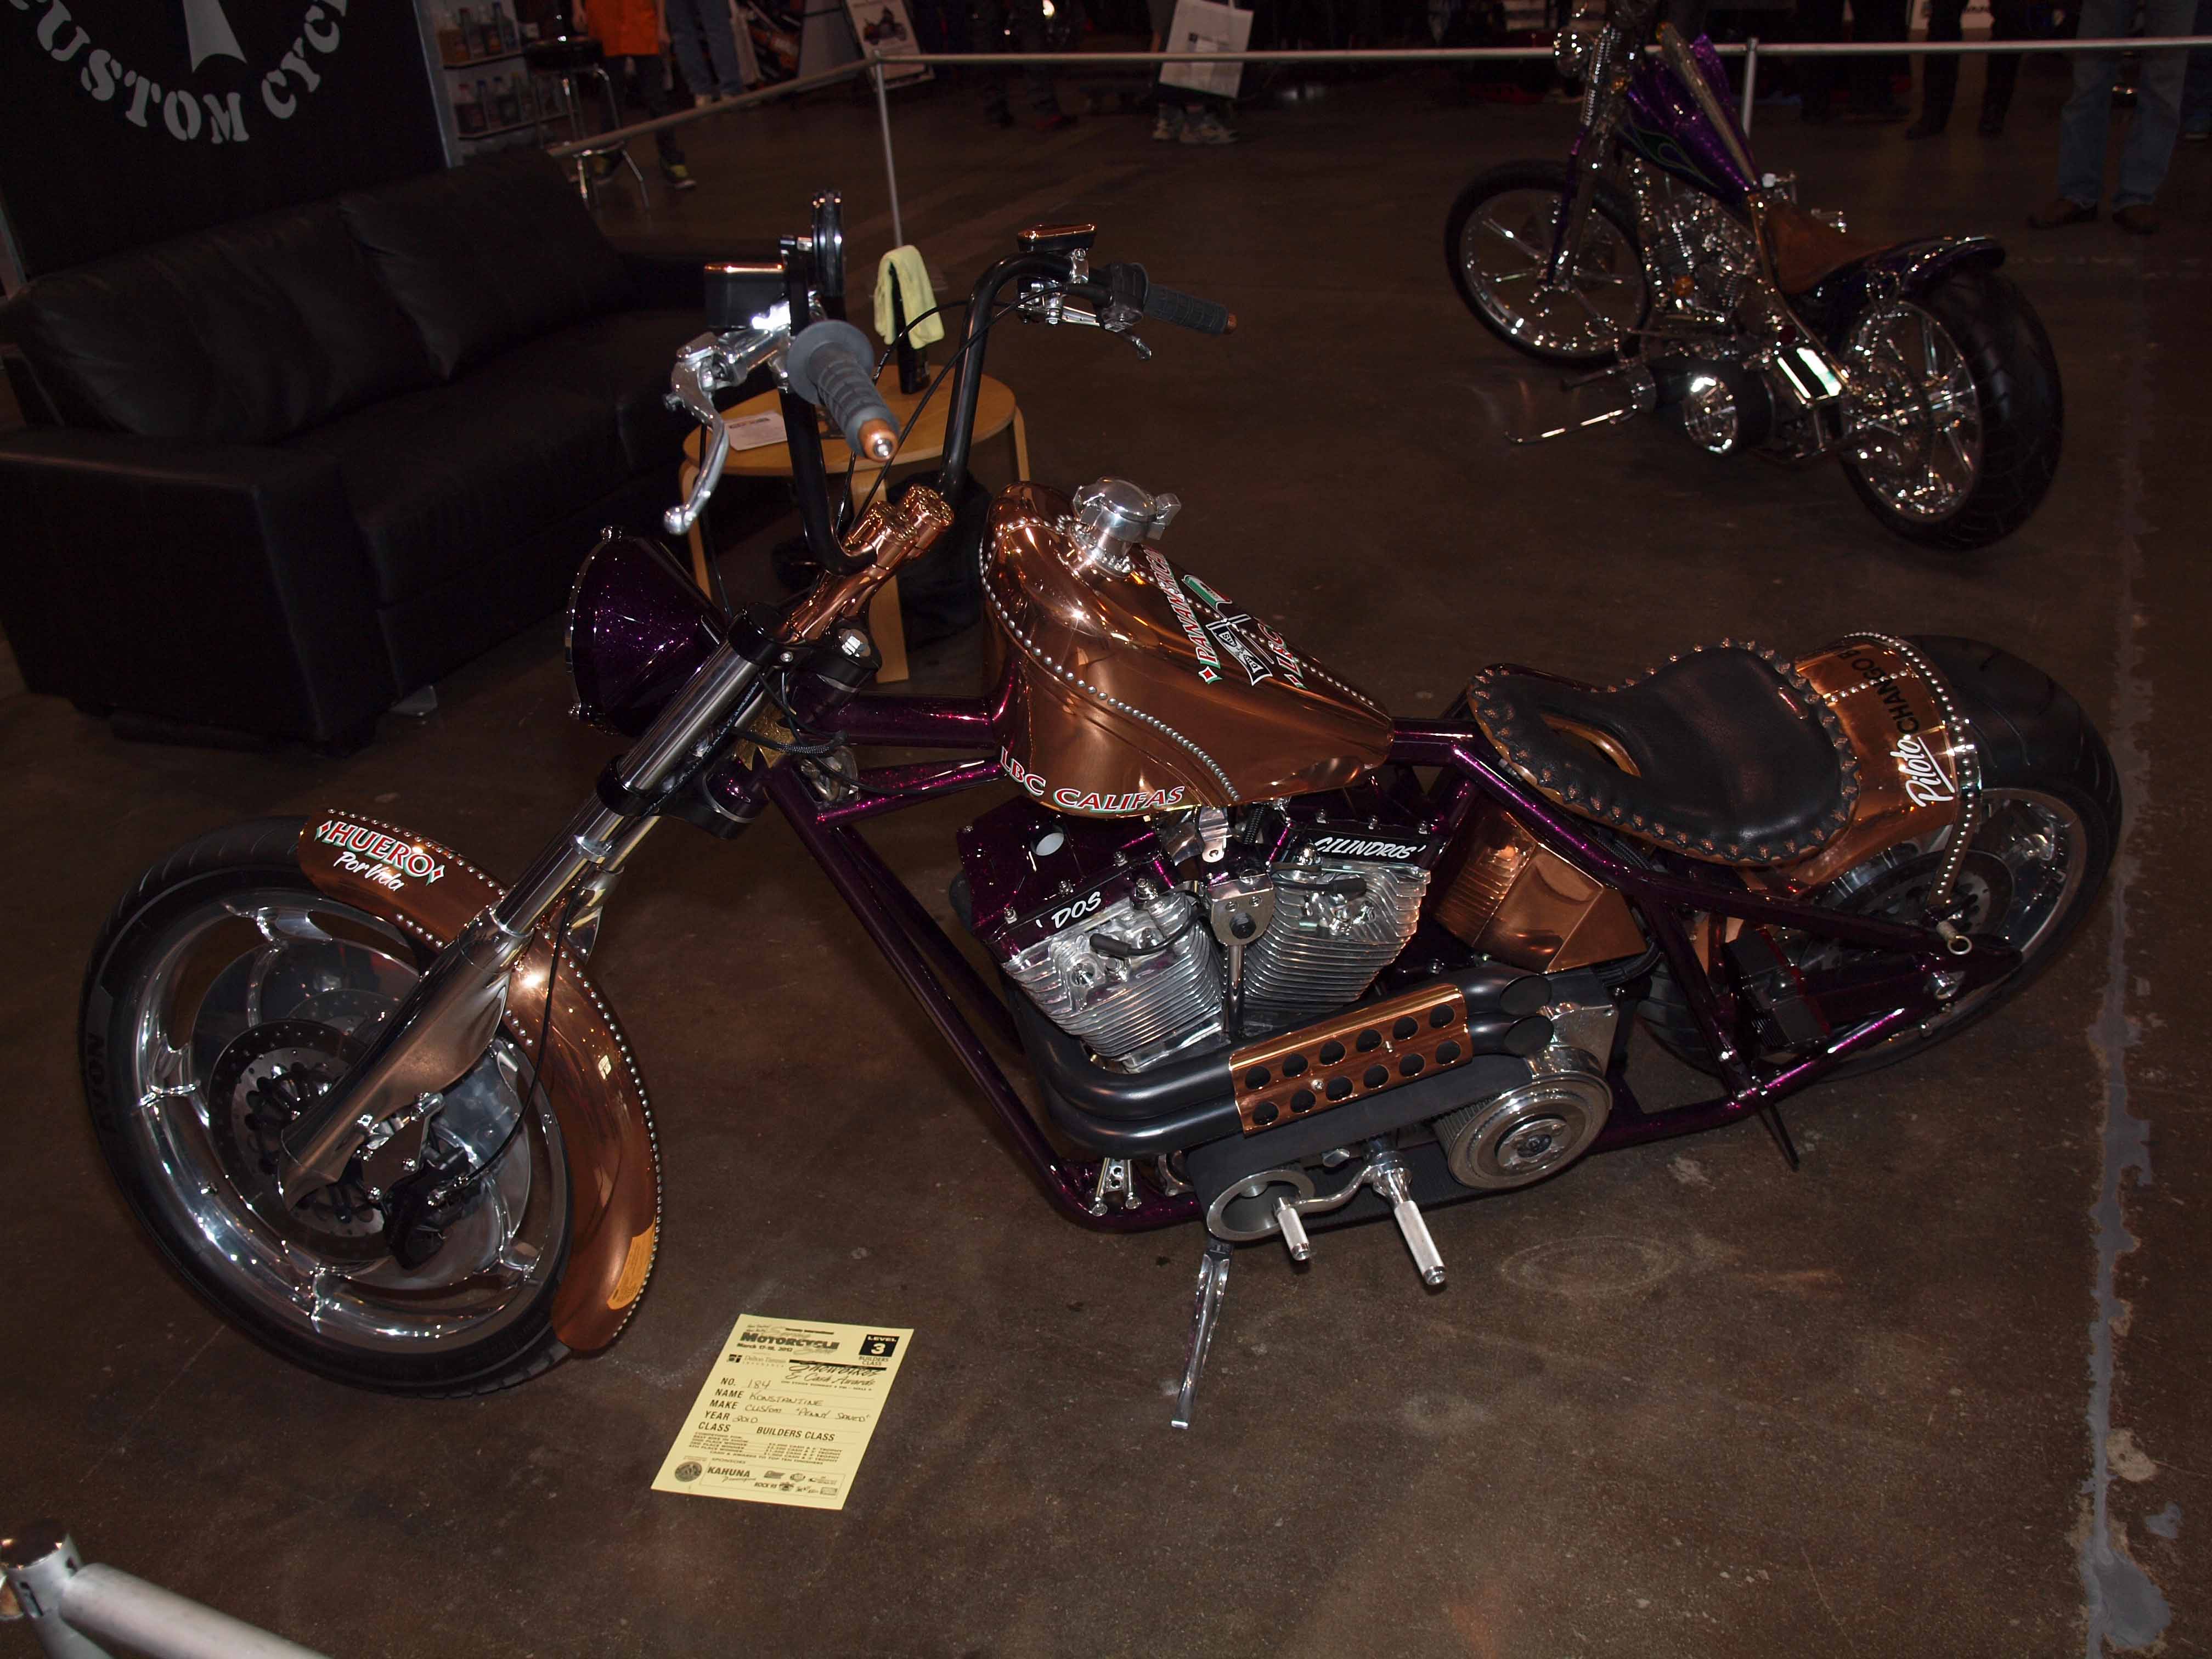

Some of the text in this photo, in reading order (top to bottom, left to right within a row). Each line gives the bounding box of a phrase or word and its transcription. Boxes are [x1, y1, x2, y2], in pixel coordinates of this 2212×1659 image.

[8, 0, 250, 144] USTOM
[1852, 658, 1920, 734] CHANGO
[1000, 746, 1186, 813] LBC CALIFAS
[321, 821, 435, 878] HUERO
[333, 851, 405, 891] Por Vida
[870, 1342, 886, 1355] 3
[720, 1378, 736, 1386] NO.
[747, 1379, 772, 1390] 184
[715, 1389, 745, 1398] NAME
[709, 1400, 739, 1409] MAKE
[704, 1410, 731, 1421] YEAR
[698, 1421, 836, 1442] CLASS BUILDERS CLASS
[707, 1466, 751, 1477] KAHUNA
